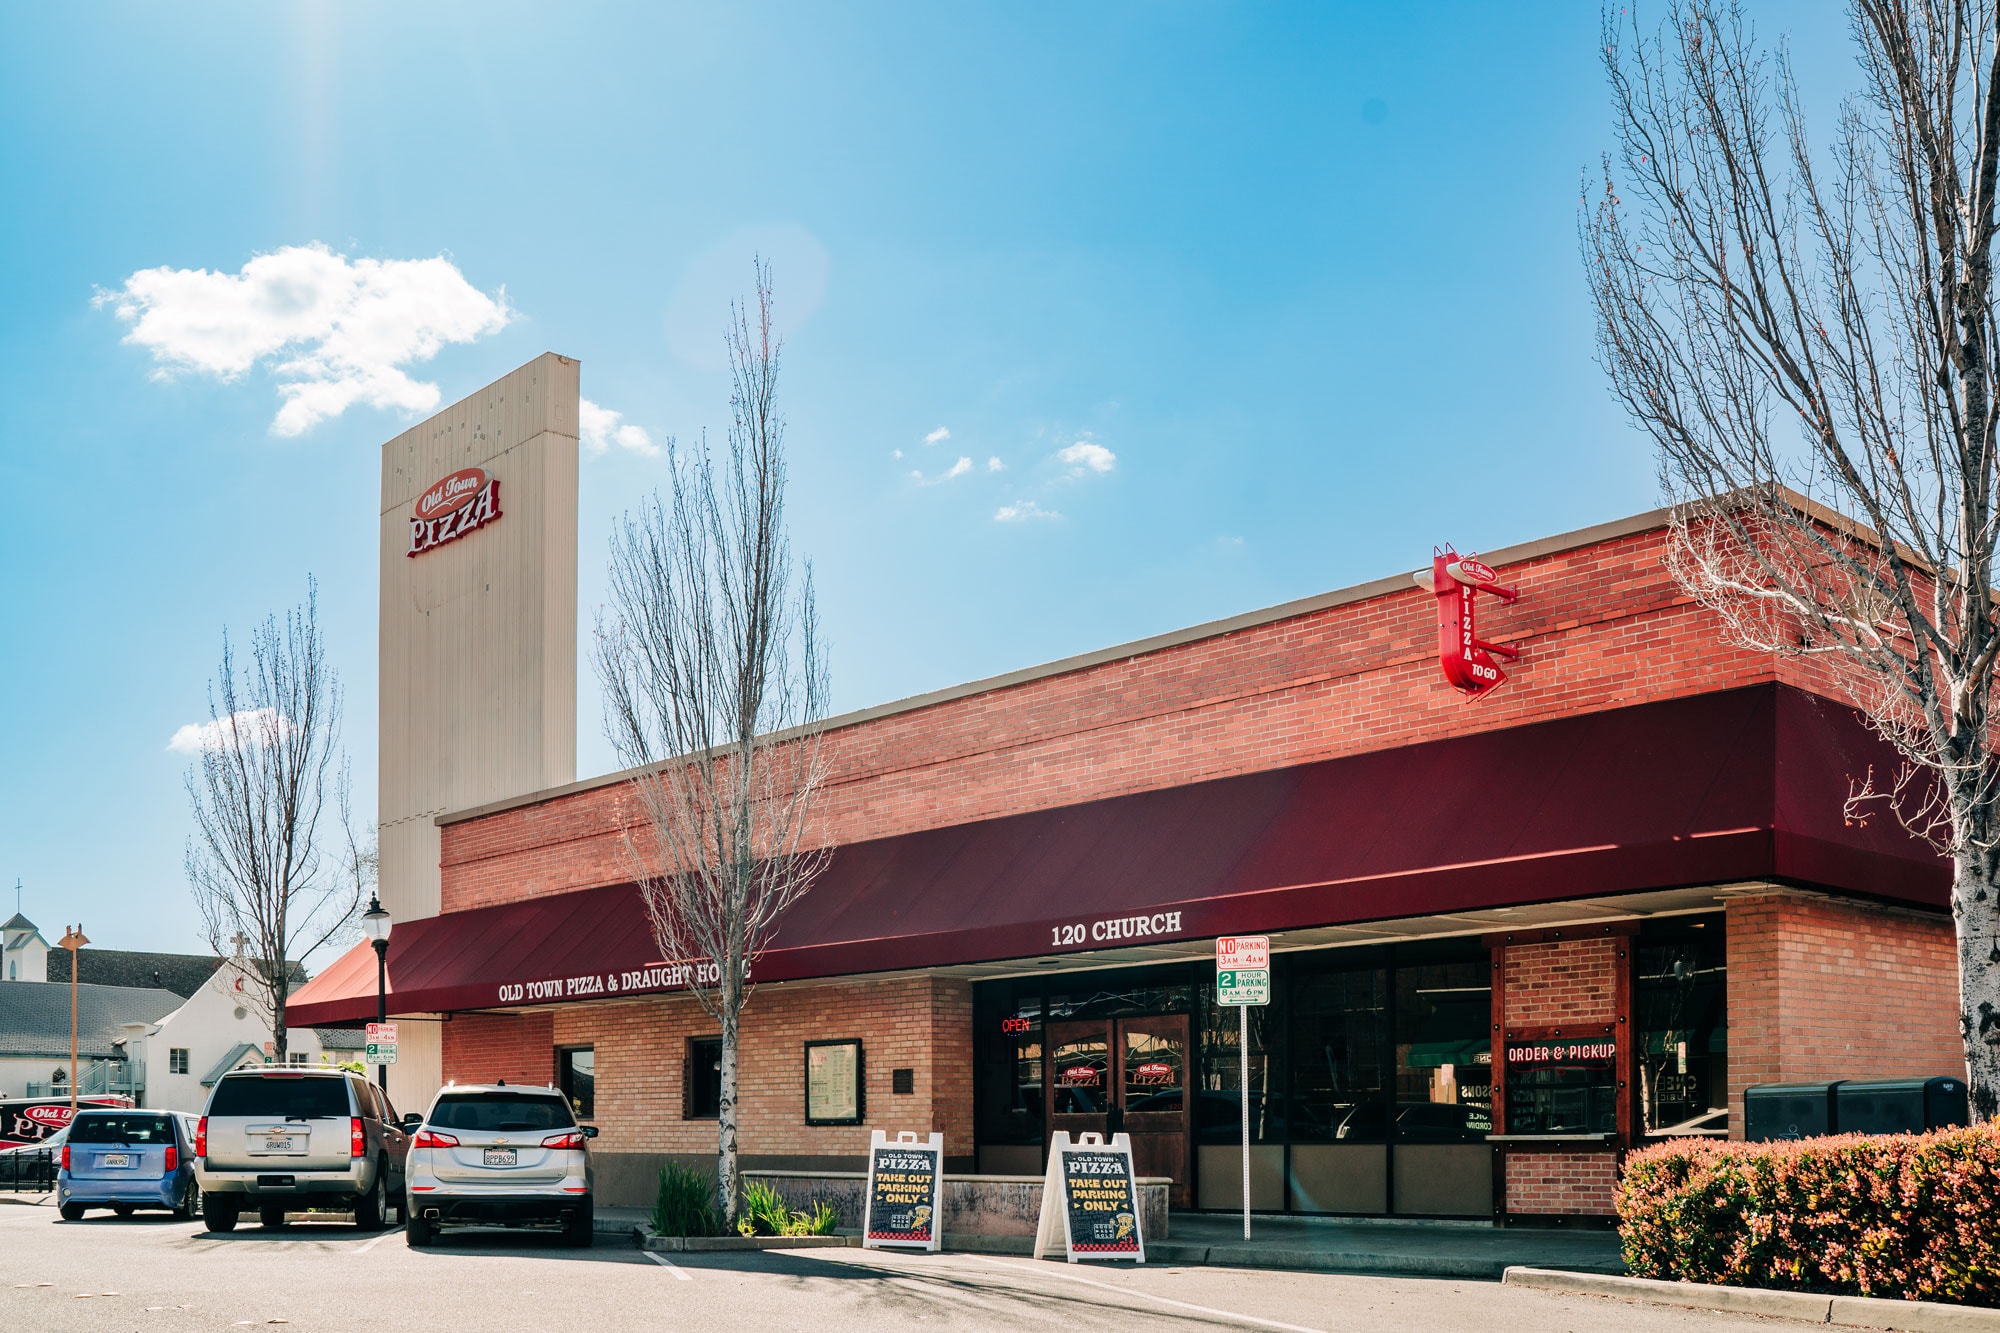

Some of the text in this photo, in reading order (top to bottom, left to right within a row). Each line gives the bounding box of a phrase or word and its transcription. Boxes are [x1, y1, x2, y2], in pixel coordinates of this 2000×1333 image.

[421, 476, 478, 512] Old Town
[406, 480, 497, 557] PIZZA
[1462, 561, 1493, 579] Old Town
[1462, 585, 1473, 661] PIZZA
[1472, 663, 1497, 680] TO GO
[1052, 911, 1182, 946] 120 CHURCH
[1219, 940, 1266, 954] NO PARKING
[498, 982, 524, 1002] OLD
[526, 979, 562, 999] TOWN
[566, 975, 604, 996] PIZZA
[607, 974, 618, 992] &
[621, 966, 692, 990] DRAUGHT
[1221, 973, 1231, 986] 2
[1237, 978, 1266, 987] PARKING
[367, 1025, 377, 1035] NO
[1002, 1018, 1030, 1033] OPEN
[368, 1045, 376, 1054] 2
[1508, 1044, 1616, 1062] ORDER & PICKUP
[1061, 1074, 1101, 1087] PIZZA
[1133, 1072, 1176, 1085] PIZZA
[32, 1108, 58, 1118] Old
[265, 1141, 292, 1149] 6RUW015
[485, 1154, 515, 1163] 8PPB699
[878, 1158, 931, 1170] PIZZA
[1068, 1161, 1125, 1174] PIZZA
[876, 1173, 932, 1183] TAKE OUT
[1068, 1178, 1128, 1188] TAKE OUT
[877, 1183, 929, 1193] PARKING
[1072, 1190, 1127, 1199] PARKING
[886, 1194, 920, 1203] ONLY
[1083, 1201, 1119, 1211] ONLY
